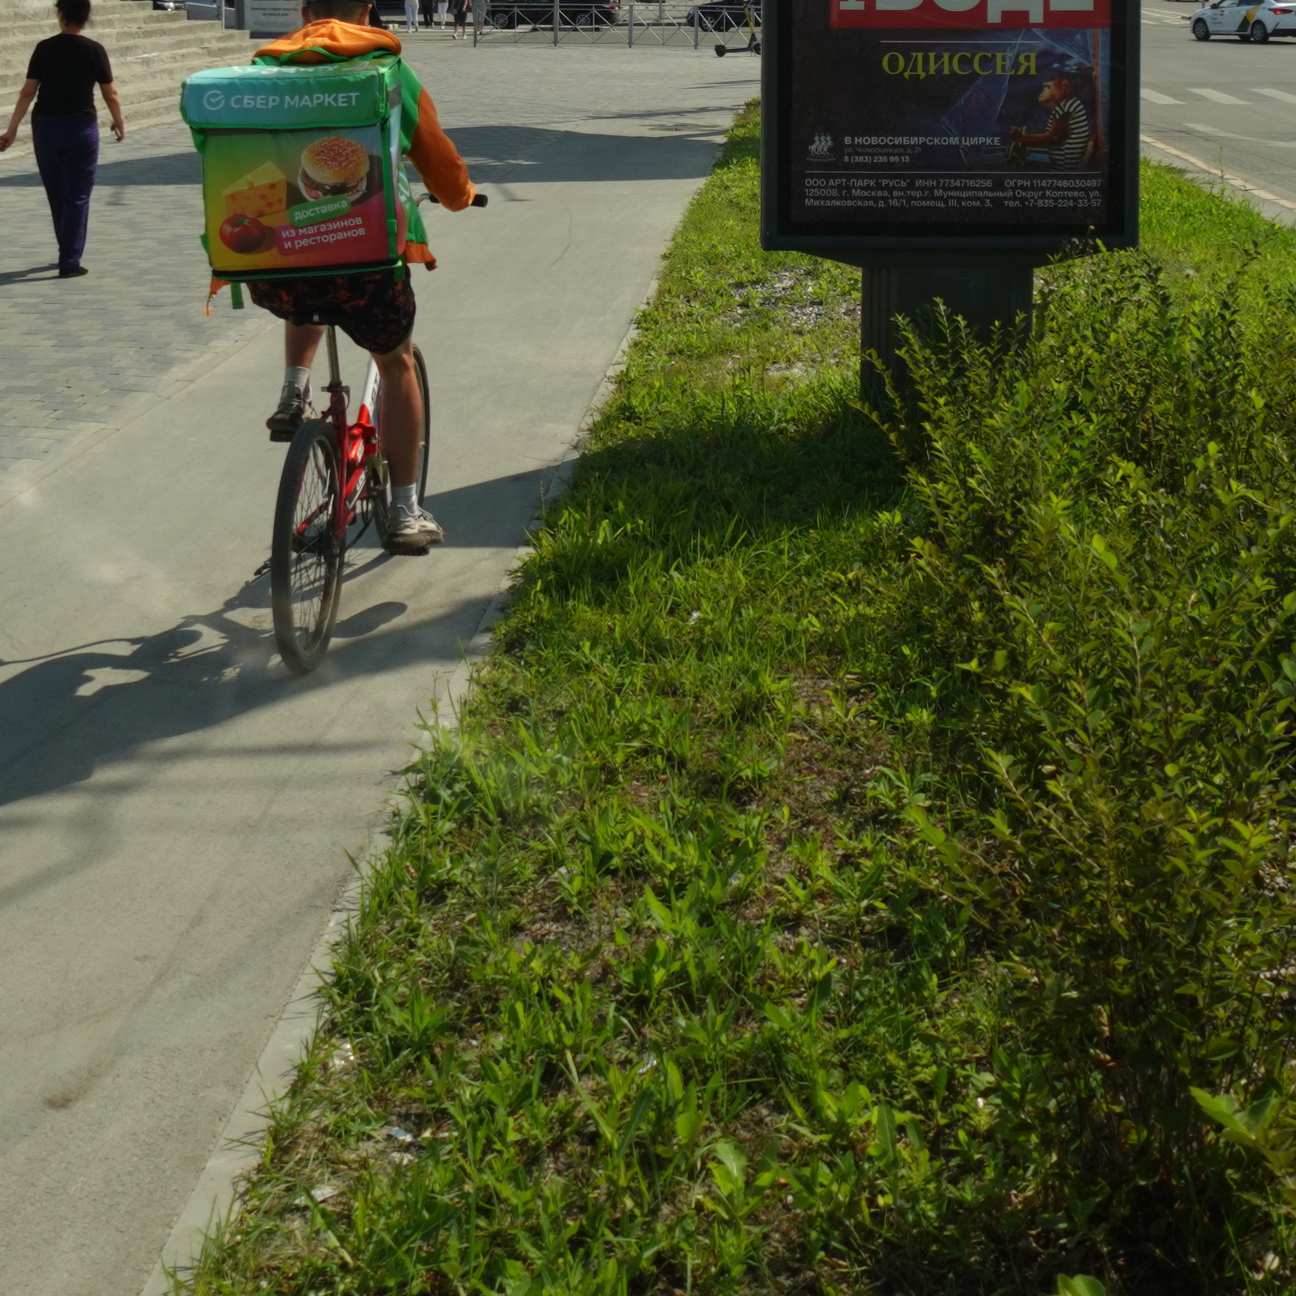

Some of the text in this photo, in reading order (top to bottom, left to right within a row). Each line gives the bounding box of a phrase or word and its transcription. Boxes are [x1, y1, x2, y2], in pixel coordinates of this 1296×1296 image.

[881, 51, 1038, 80] ОДИССЕЯ
[230, 92, 360, 109] СБЕР МАРКЕТ
[844, 136, 1001, 147] В НОВОСИБИРСКОМ ЦИРКЕ
[804, 178, 827, 187] ООО
[828, 178, 876, 187] АРТ-ПАРК
[915, 178, 937, 187] ИНН
[1004, 178, 1031, 187] ОГРН
[293, 199, 348, 222] доставка
[281, 217, 363, 239] из магазинов
[284, 227, 366, 250] и ресторанов
